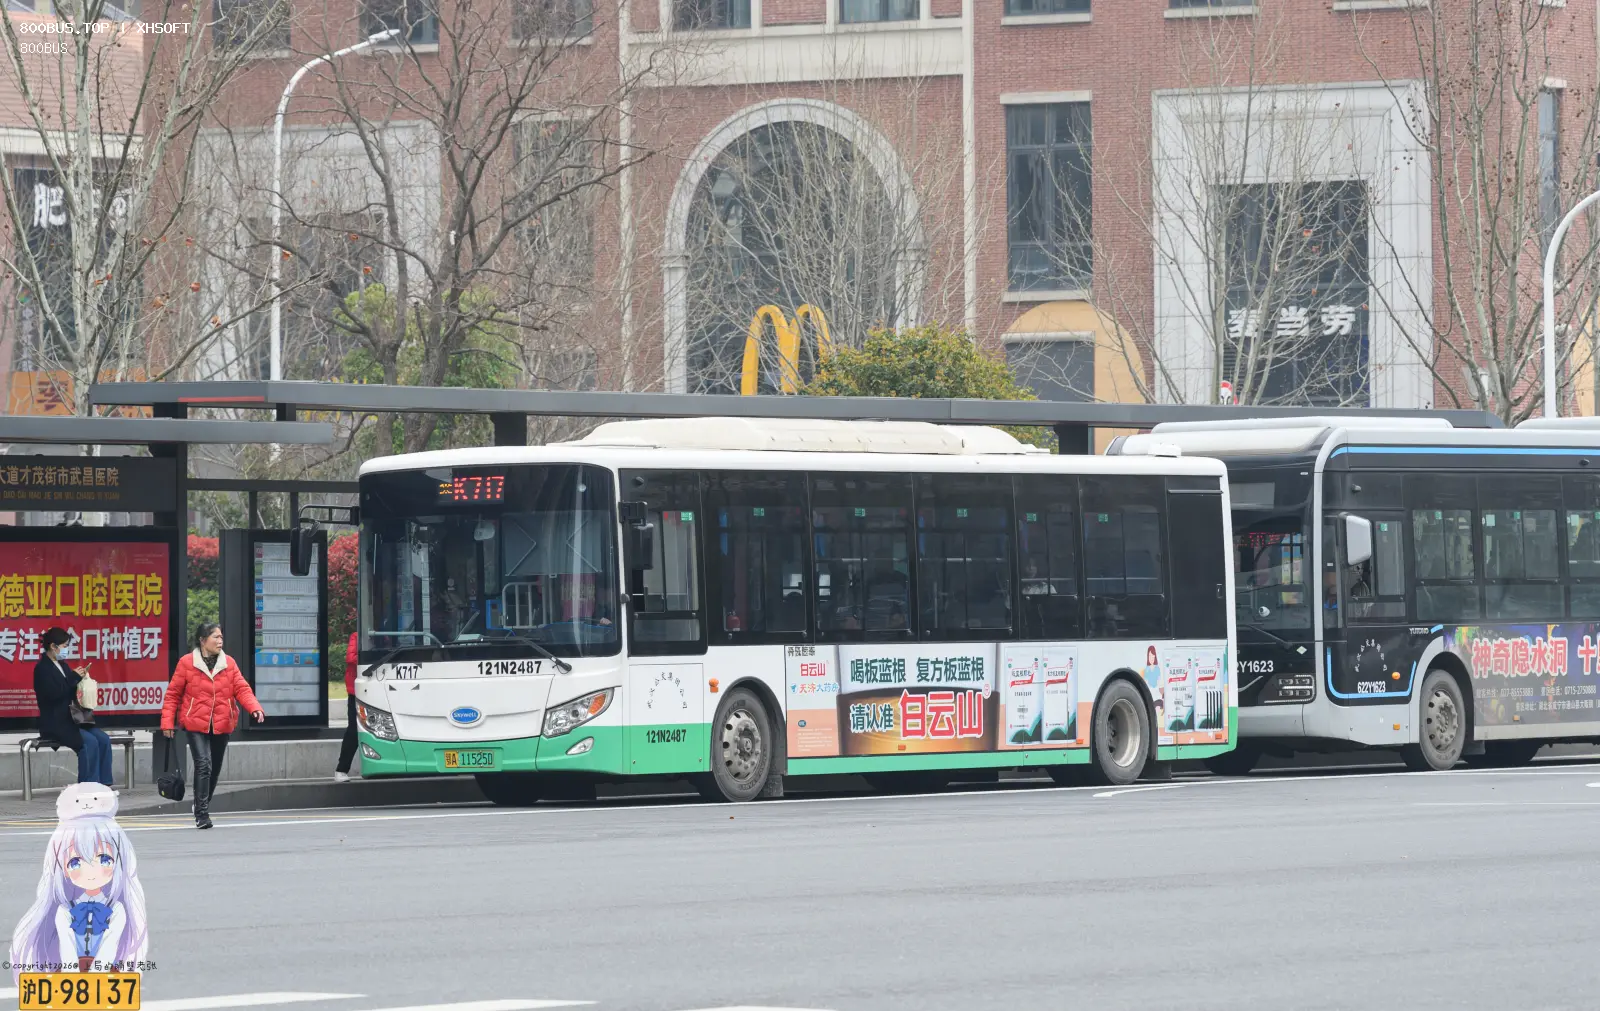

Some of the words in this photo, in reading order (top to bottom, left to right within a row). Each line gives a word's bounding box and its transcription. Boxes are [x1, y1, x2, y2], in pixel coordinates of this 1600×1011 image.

[454, 475, 504, 500] K717
[0, 573, 163, 618] 德亚口腔医院
[0, 627, 162, 662] 专注全口种植牙
[478, 660, 542, 675] 121N2487
[800, 663, 826, 677] 白云山
[850, 658, 907, 684] 喝板蓝根
[916, 656, 985, 683] 复方板蓝根
[1472, 637, 1568, 679] 神奇隐水洞
[396, 666, 418, 679] K717
[97, 687, 129, 706] 8700
[131, 686, 163, 704] 9999
[850, 703, 894, 734] 请认准
[899, 689, 984, 739] 白云山
[646, 729, 687, 743] 121N2487
